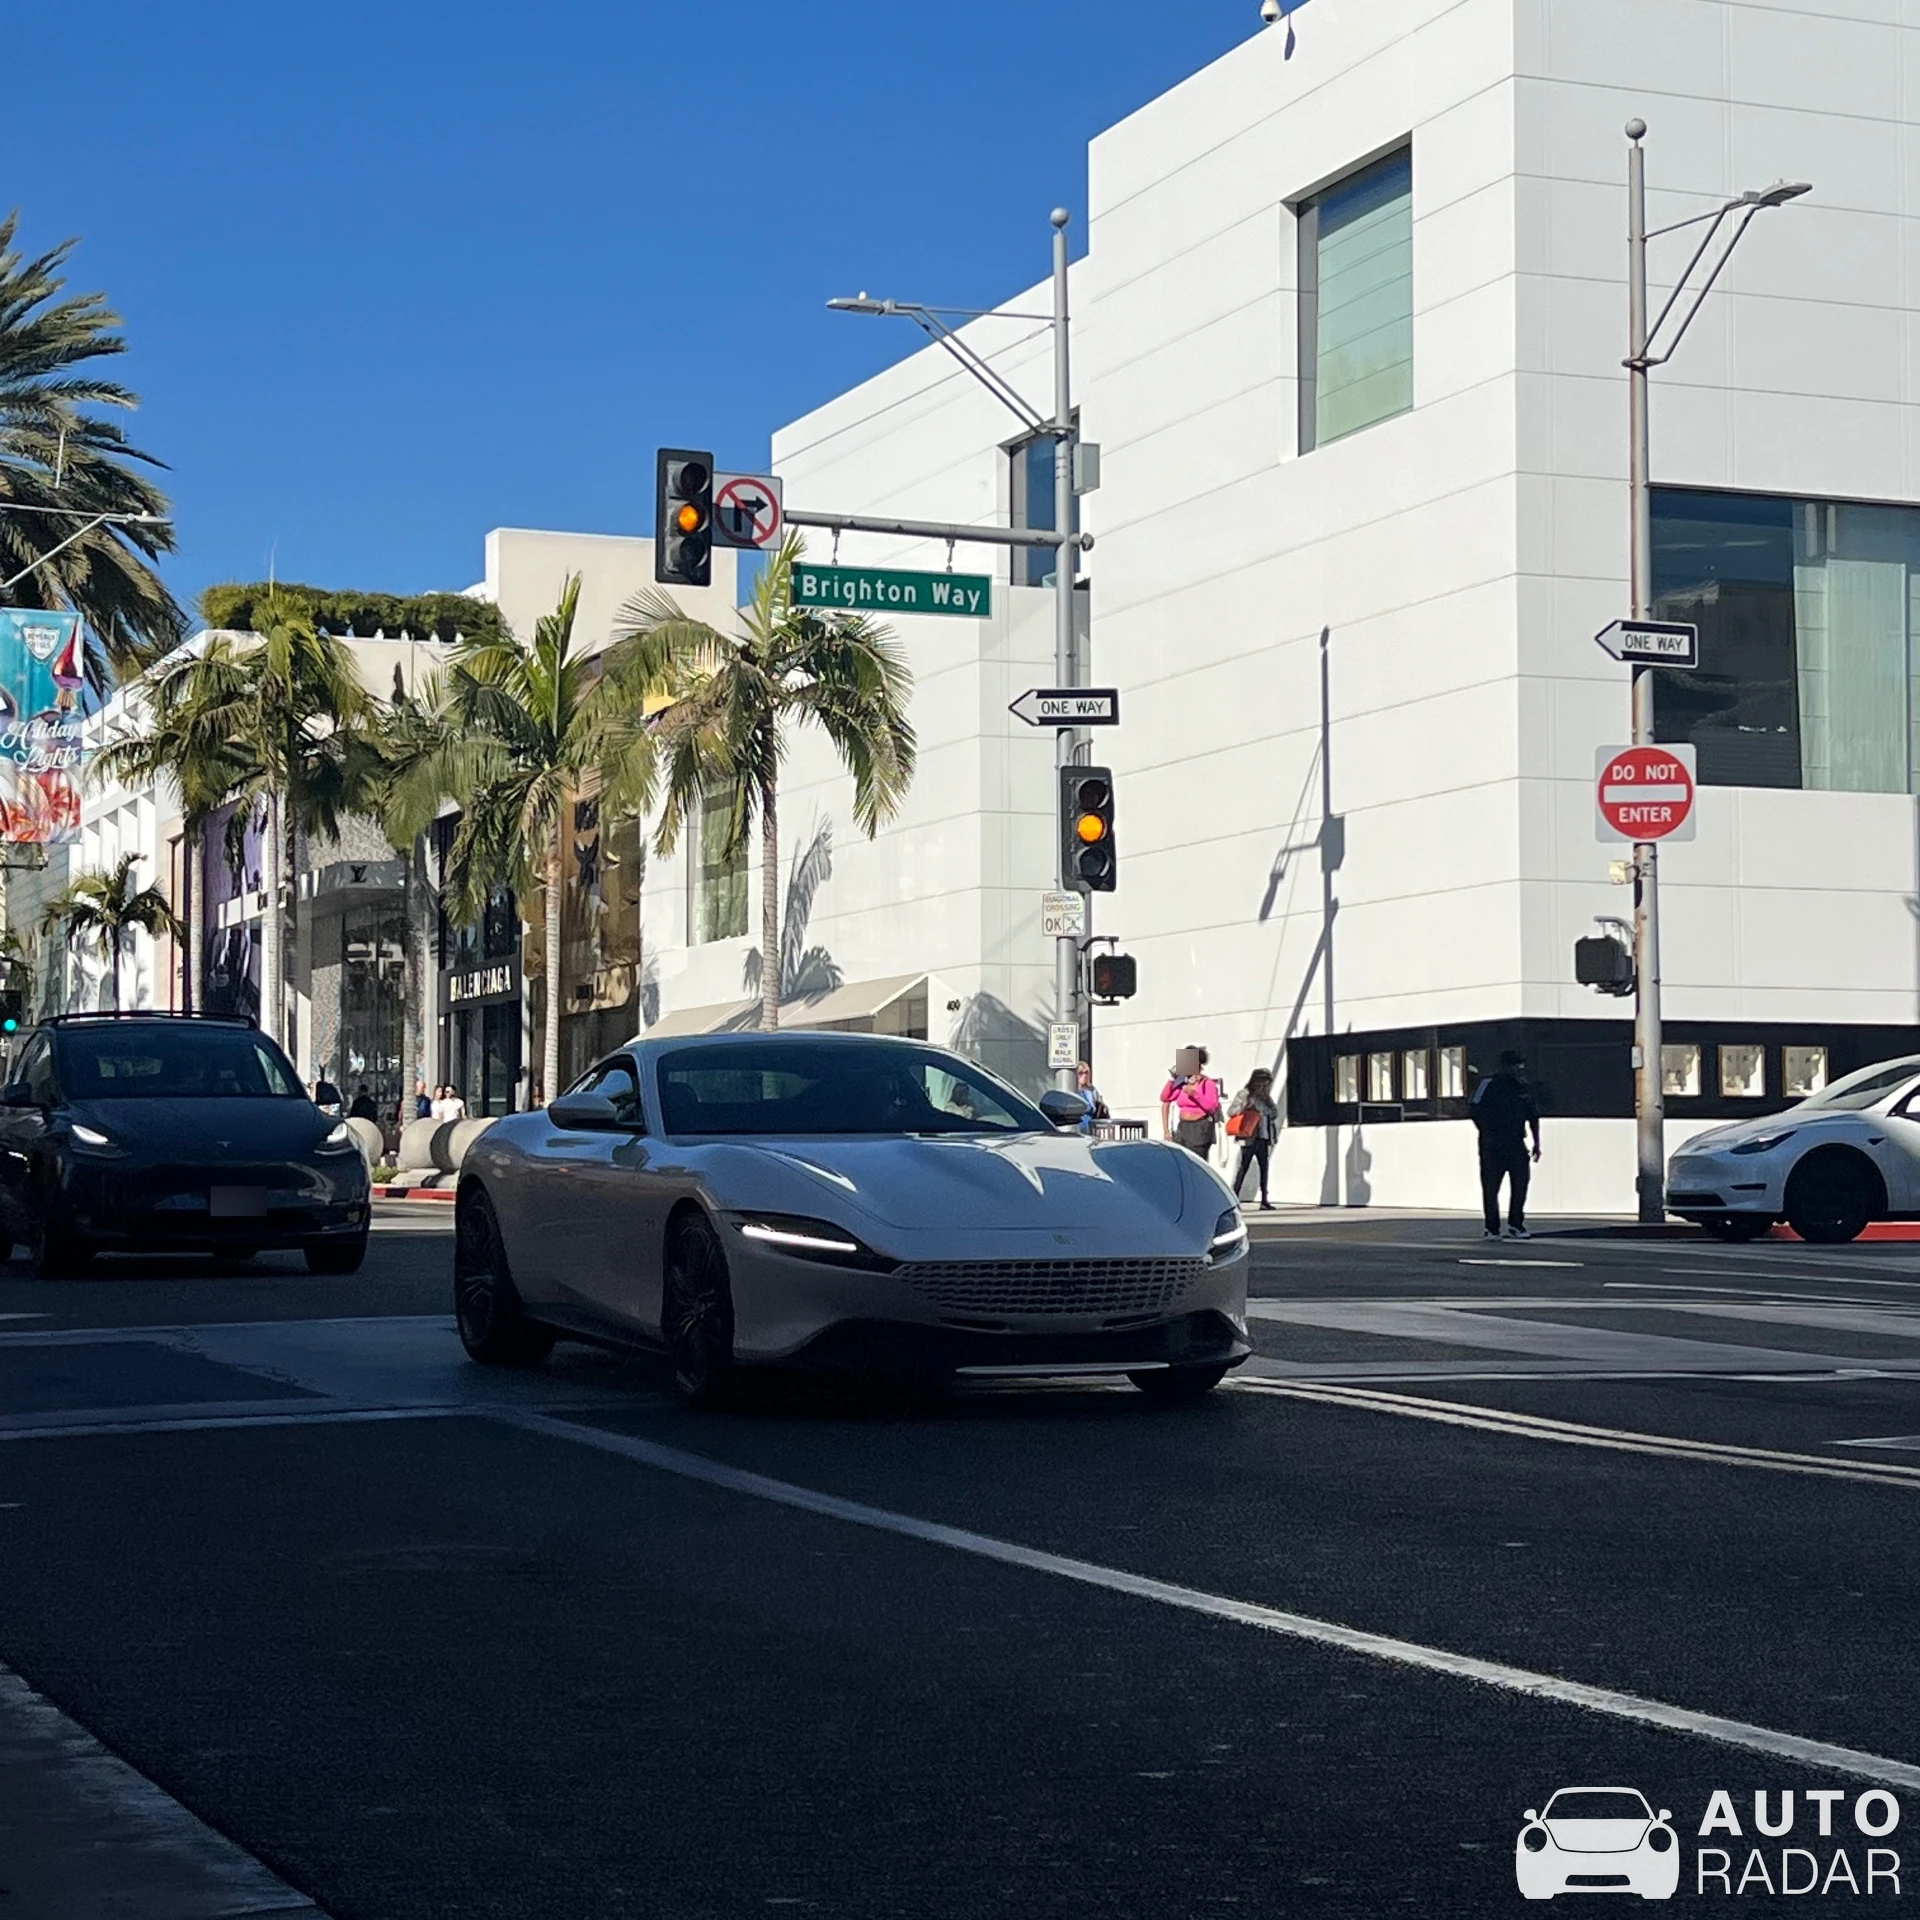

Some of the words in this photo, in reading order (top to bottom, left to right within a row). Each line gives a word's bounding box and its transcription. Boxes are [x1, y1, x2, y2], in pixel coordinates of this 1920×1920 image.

[802, 574, 916, 606] Brighton
[932, 582, 981, 612] Way
[1625, 633, 1651, 650] ONE
[1656, 636, 1684, 652] WAY
[1041, 700, 1070, 715] ONE
[1075, 700, 1105, 714] WAY
[1, 719, 77, 750] Holiday
[13, 744, 79, 772] Lights
[1612, 765, 1635, 781] DO
[1645, 763, 1678, 780] NOT
[1618, 806, 1672, 823] ENTER
[1045, 903, 1081, 912] CROSSING
[1045, 917, 1062, 932] OK
[450, 965, 511, 1002] BALENCIAGA
